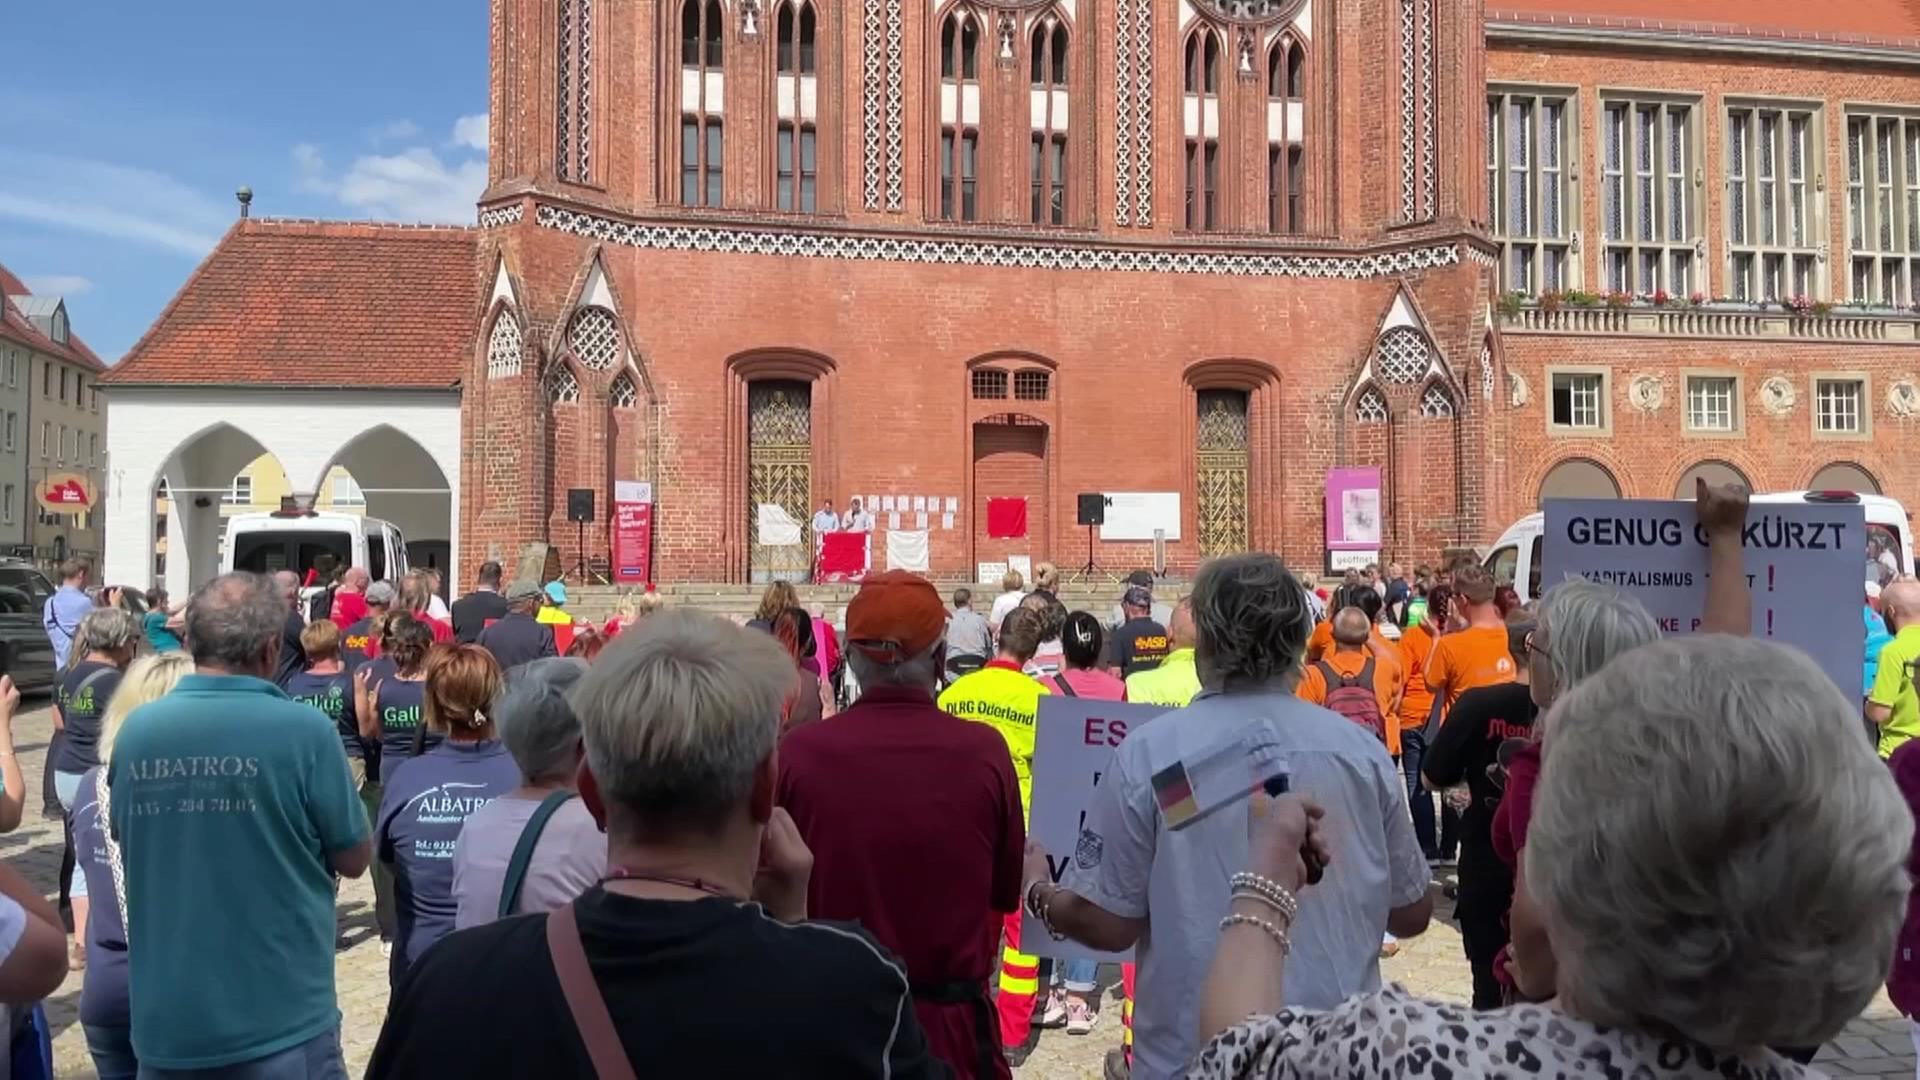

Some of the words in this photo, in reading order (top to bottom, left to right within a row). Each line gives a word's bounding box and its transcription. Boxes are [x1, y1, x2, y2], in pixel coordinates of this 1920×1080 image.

[1567, 517, 1682, 546] GENUG
[1694, 515, 1847, 549] GKÜRZT
[1145, 636, 1167, 648] ASB
[384, 706, 420, 722] Gall
[946, 700, 975, 715] DLRG
[977, 701, 1035, 726] Oderland
[128, 756, 259, 781] ALBATROS
